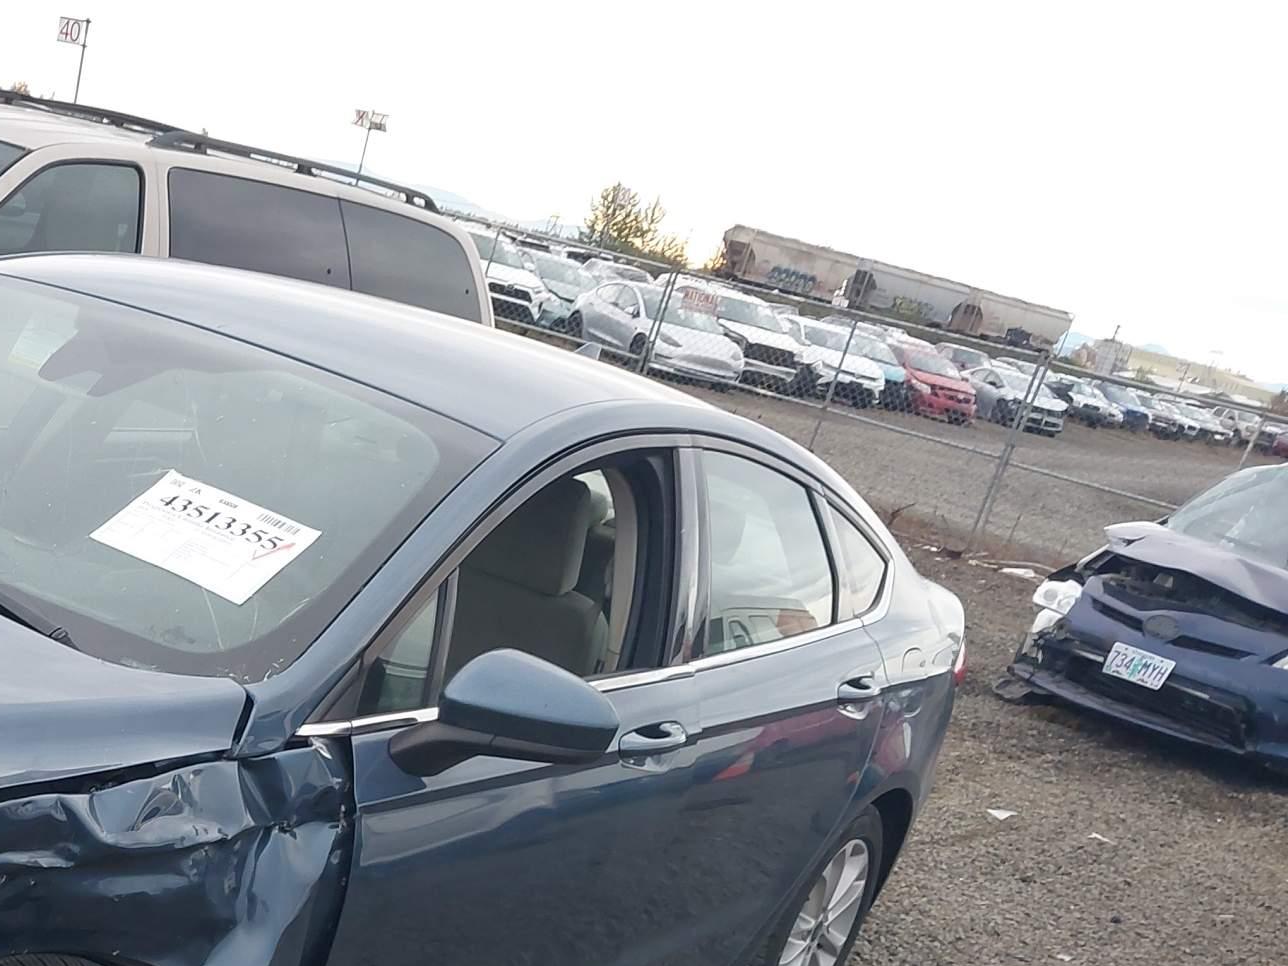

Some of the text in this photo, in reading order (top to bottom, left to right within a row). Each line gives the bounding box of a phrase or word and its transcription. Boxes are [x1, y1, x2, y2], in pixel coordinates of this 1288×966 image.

[59, 19, 81, 42] 40
[160, 494, 285, 550] 43513355
[1110, 650, 1136, 671] 734
[1137, 660, 1169, 682] MYH
